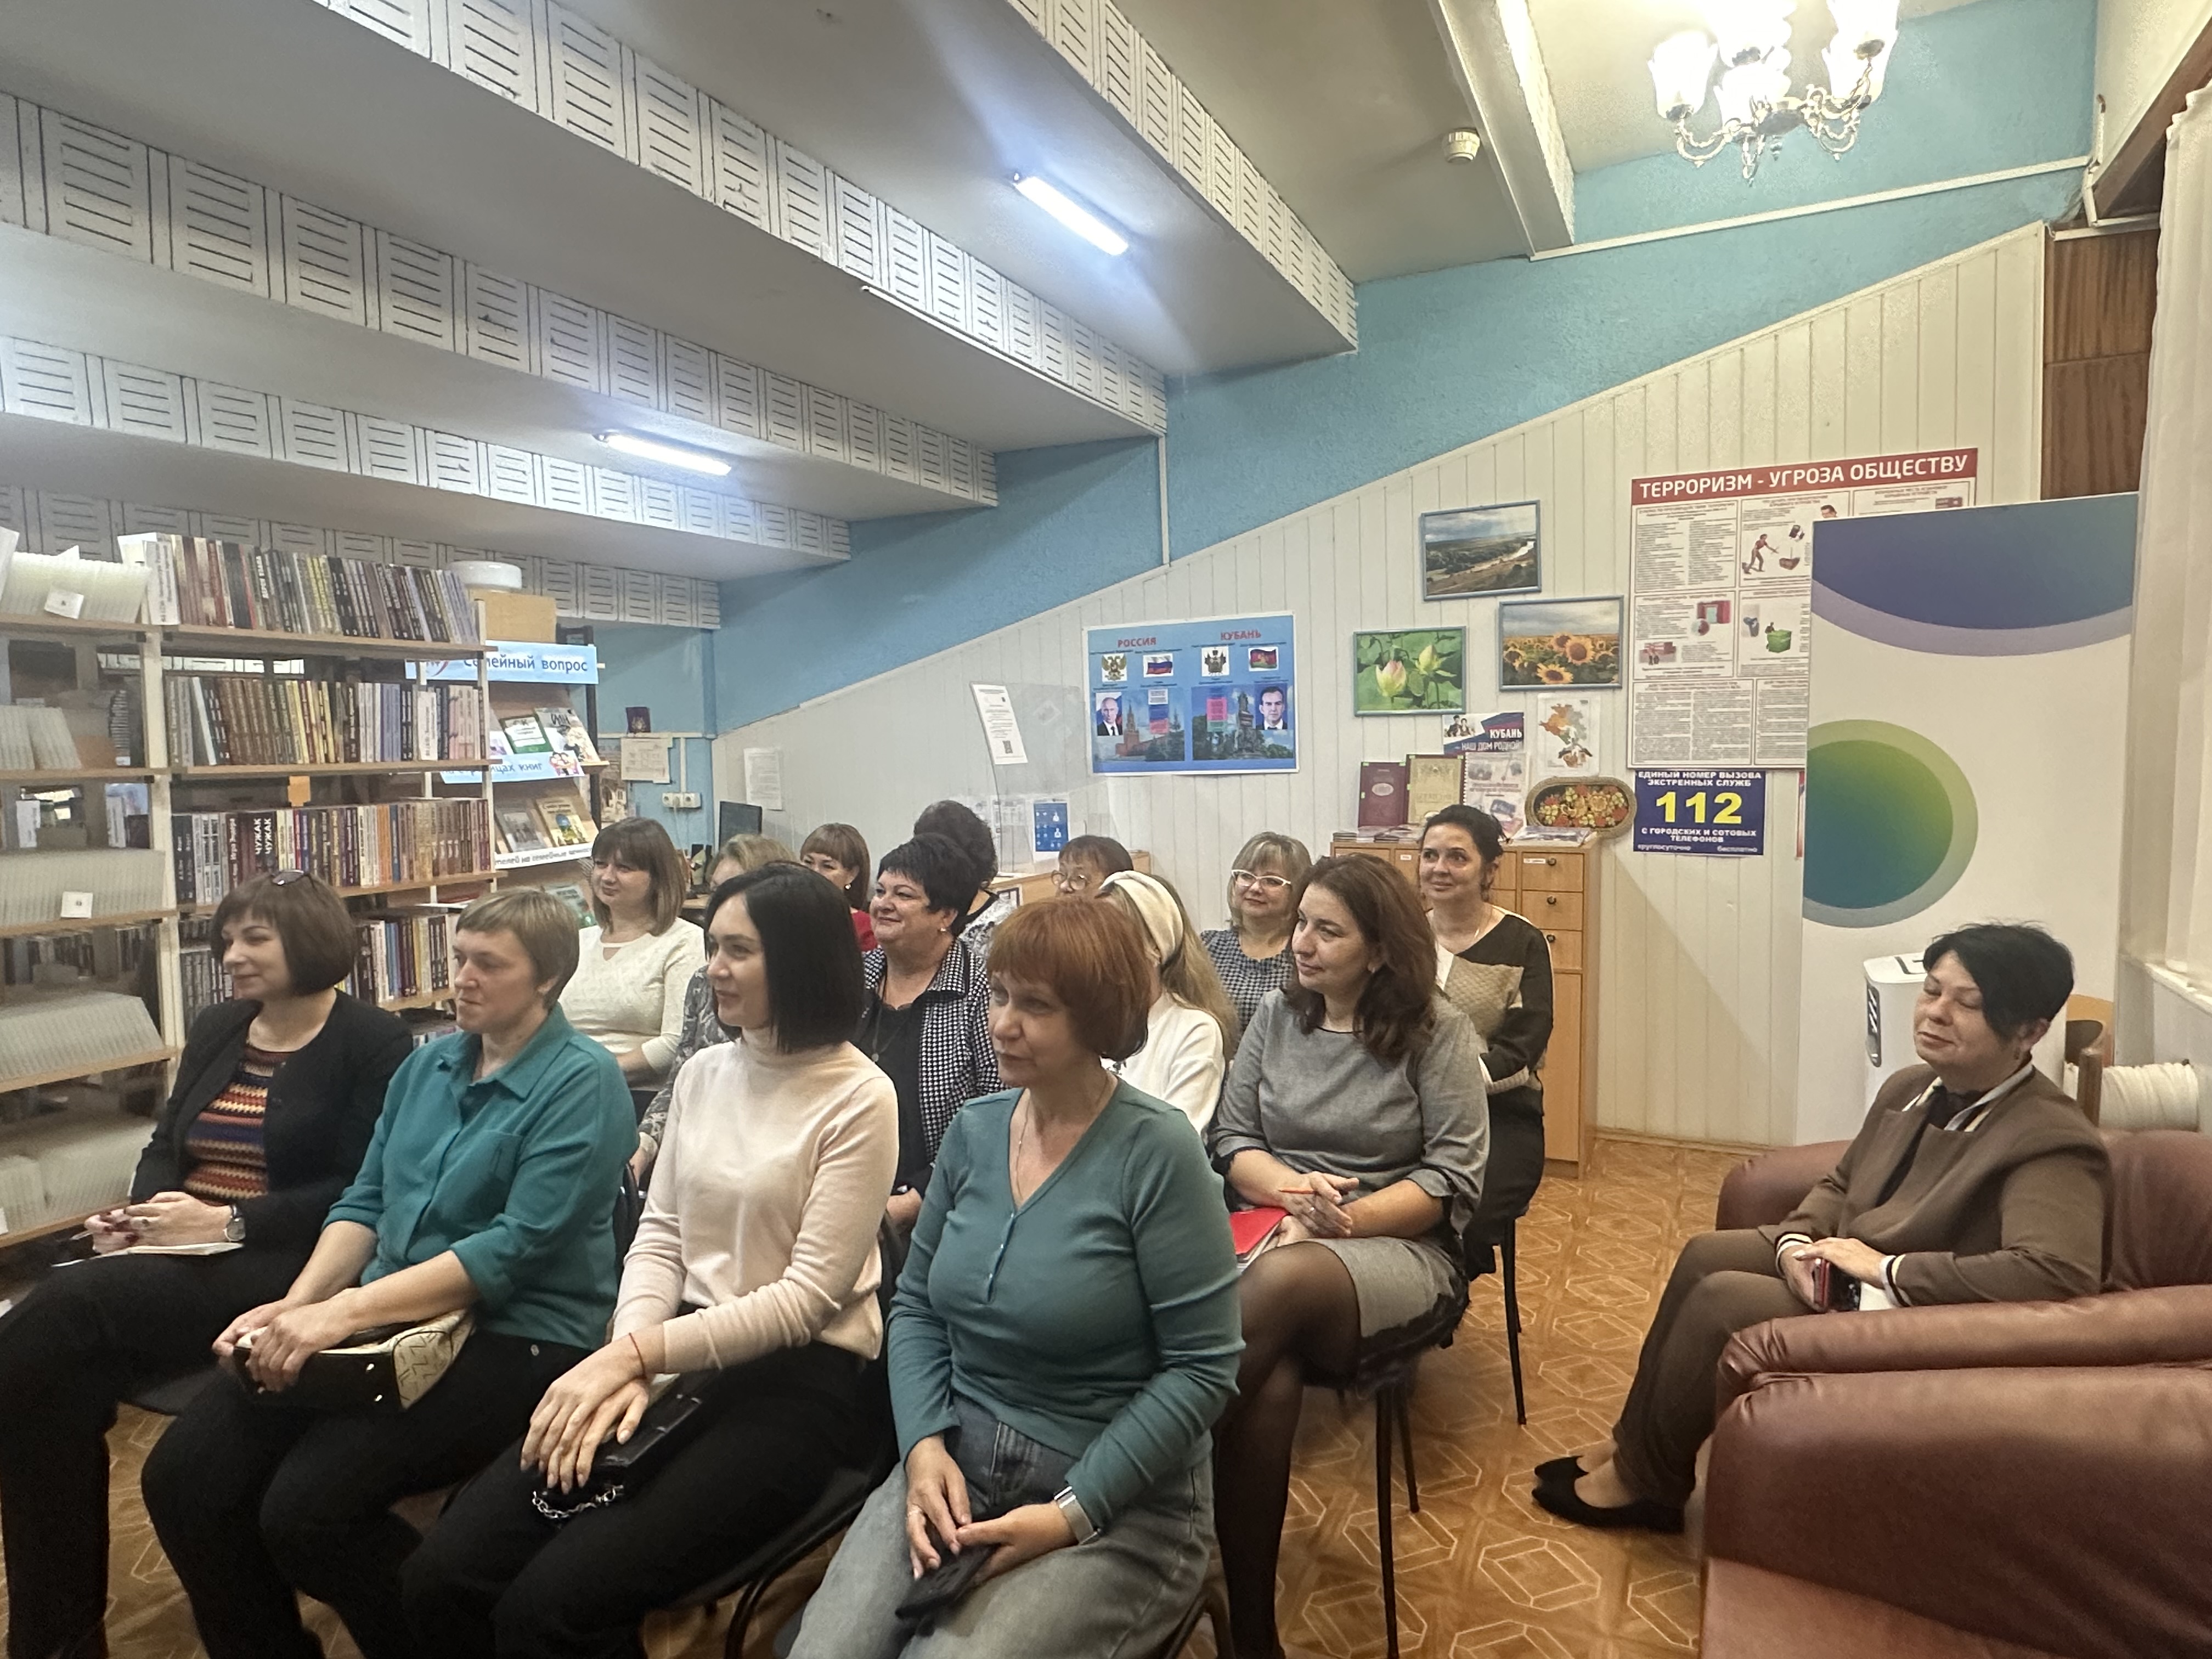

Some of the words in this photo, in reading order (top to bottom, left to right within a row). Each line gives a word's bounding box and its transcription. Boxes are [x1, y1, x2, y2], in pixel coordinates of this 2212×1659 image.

[1639, 473, 1752, 498] ТЕРРОРИЗМ
[1769, 465, 1844, 487] УГРОЗА
[1850, 454, 1967, 480] ОБЩЕСТВУ
[1117, 636, 1156, 648] РОССИЯ
[1220, 629, 1262, 641] КУБАНЬ
[541, 659, 588, 674] вопрос
[1489, 729, 1523, 738] КУБАНЬ
[1462, 742, 1476, 751] НАШ
[1477, 742, 1492, 751] ДОМ
[1656, 791, 1742, 824] 112
[253, 818, 262, 855] ЧУЖАК
[263, 818, 273, 855] ЧУЖАК
